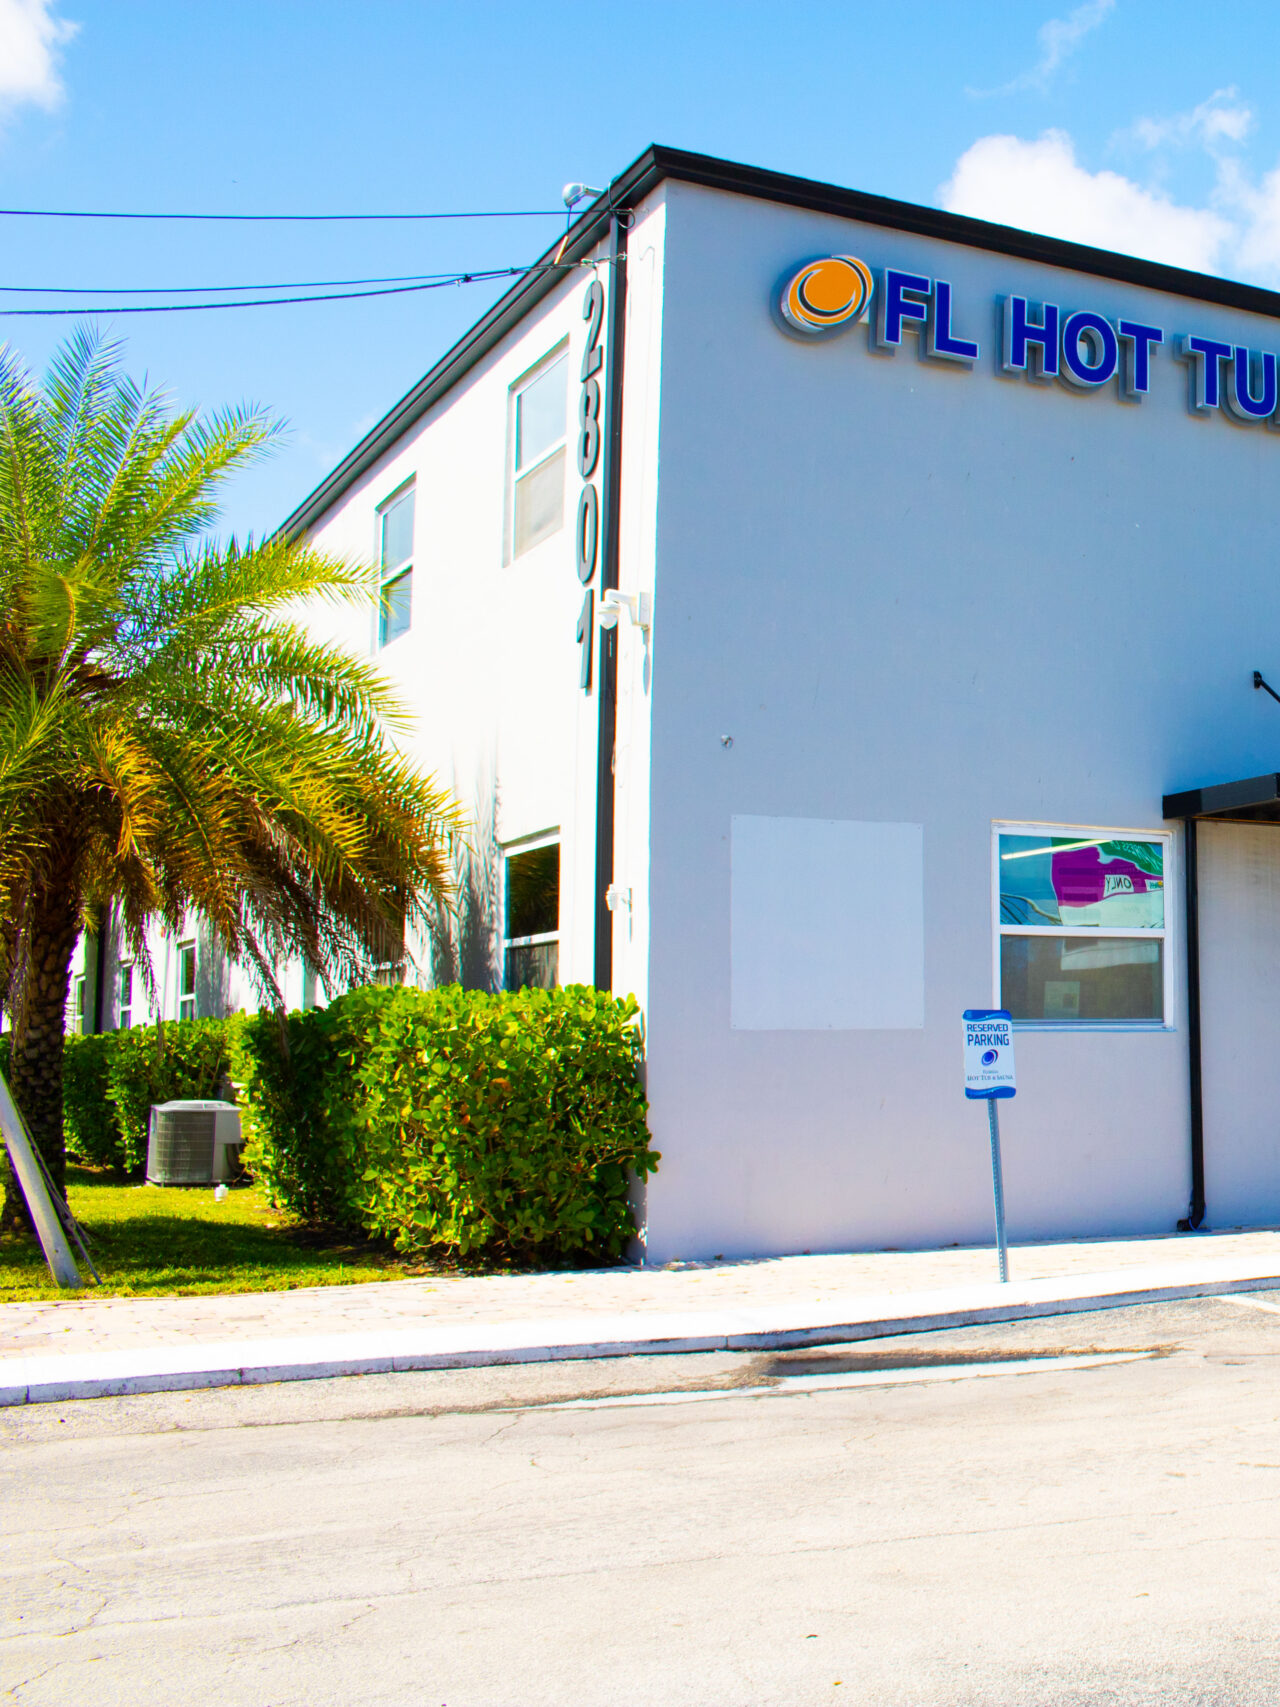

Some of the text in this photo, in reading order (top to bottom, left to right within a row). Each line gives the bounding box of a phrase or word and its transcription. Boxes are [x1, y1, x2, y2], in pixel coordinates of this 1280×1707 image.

[882, 267, 980, 361] FL
[1007, 294, 1165, 395] HOT
[576, 280, 604, 692] 2801
[967, 1024, 1008, 1032] RESERVED
[967, 1033, 1010, 1046] PARKING
